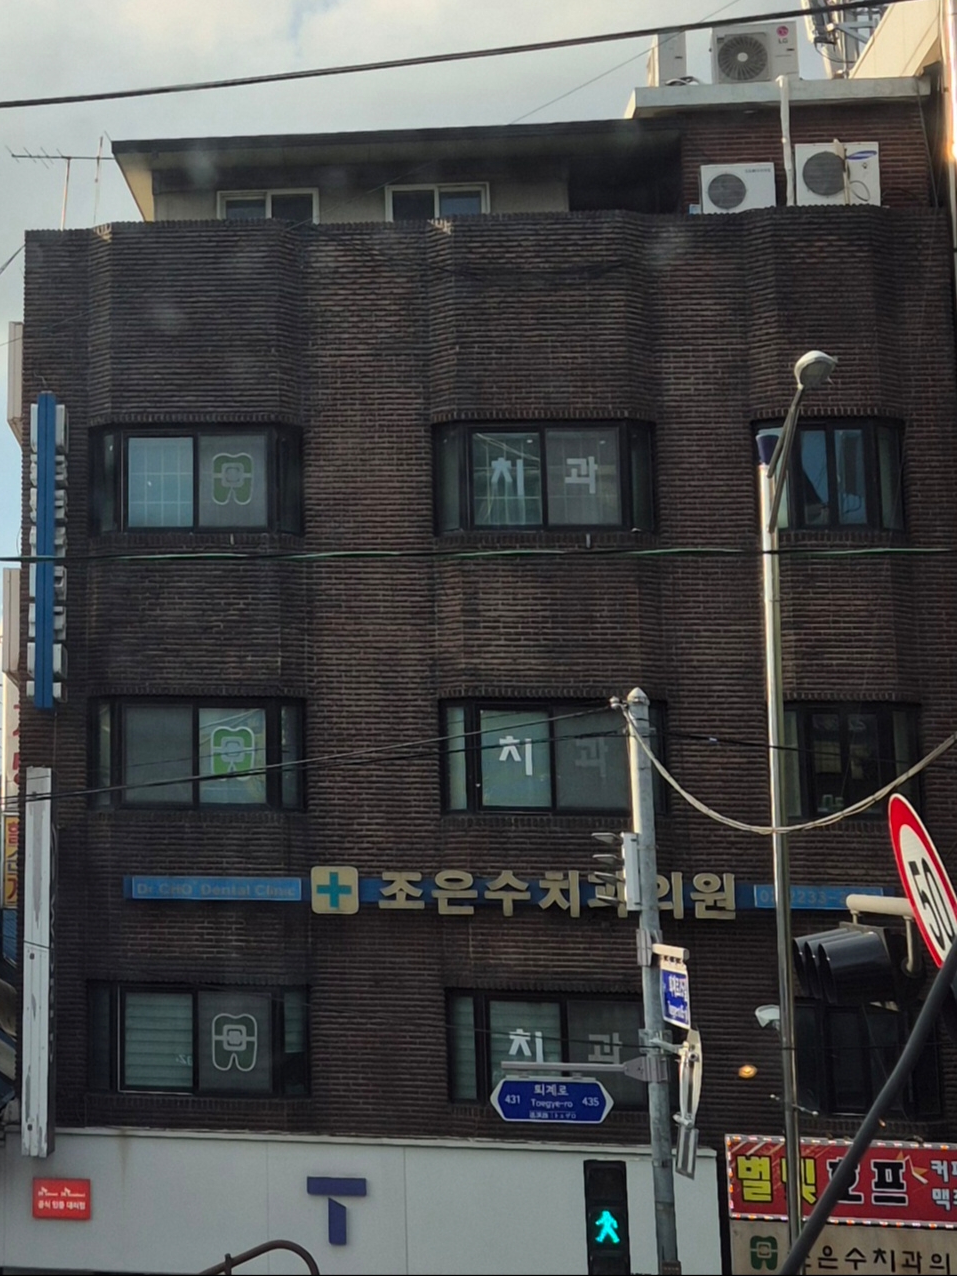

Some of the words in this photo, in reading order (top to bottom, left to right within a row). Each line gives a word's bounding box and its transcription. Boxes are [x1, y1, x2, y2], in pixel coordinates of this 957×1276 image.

[908, 857, 955, 951] 50
[533, 1083, 569, 1097] 퇴계로
[504, 1094, 521, 1105] 431
[581, 1096, 600, 1107] 435
